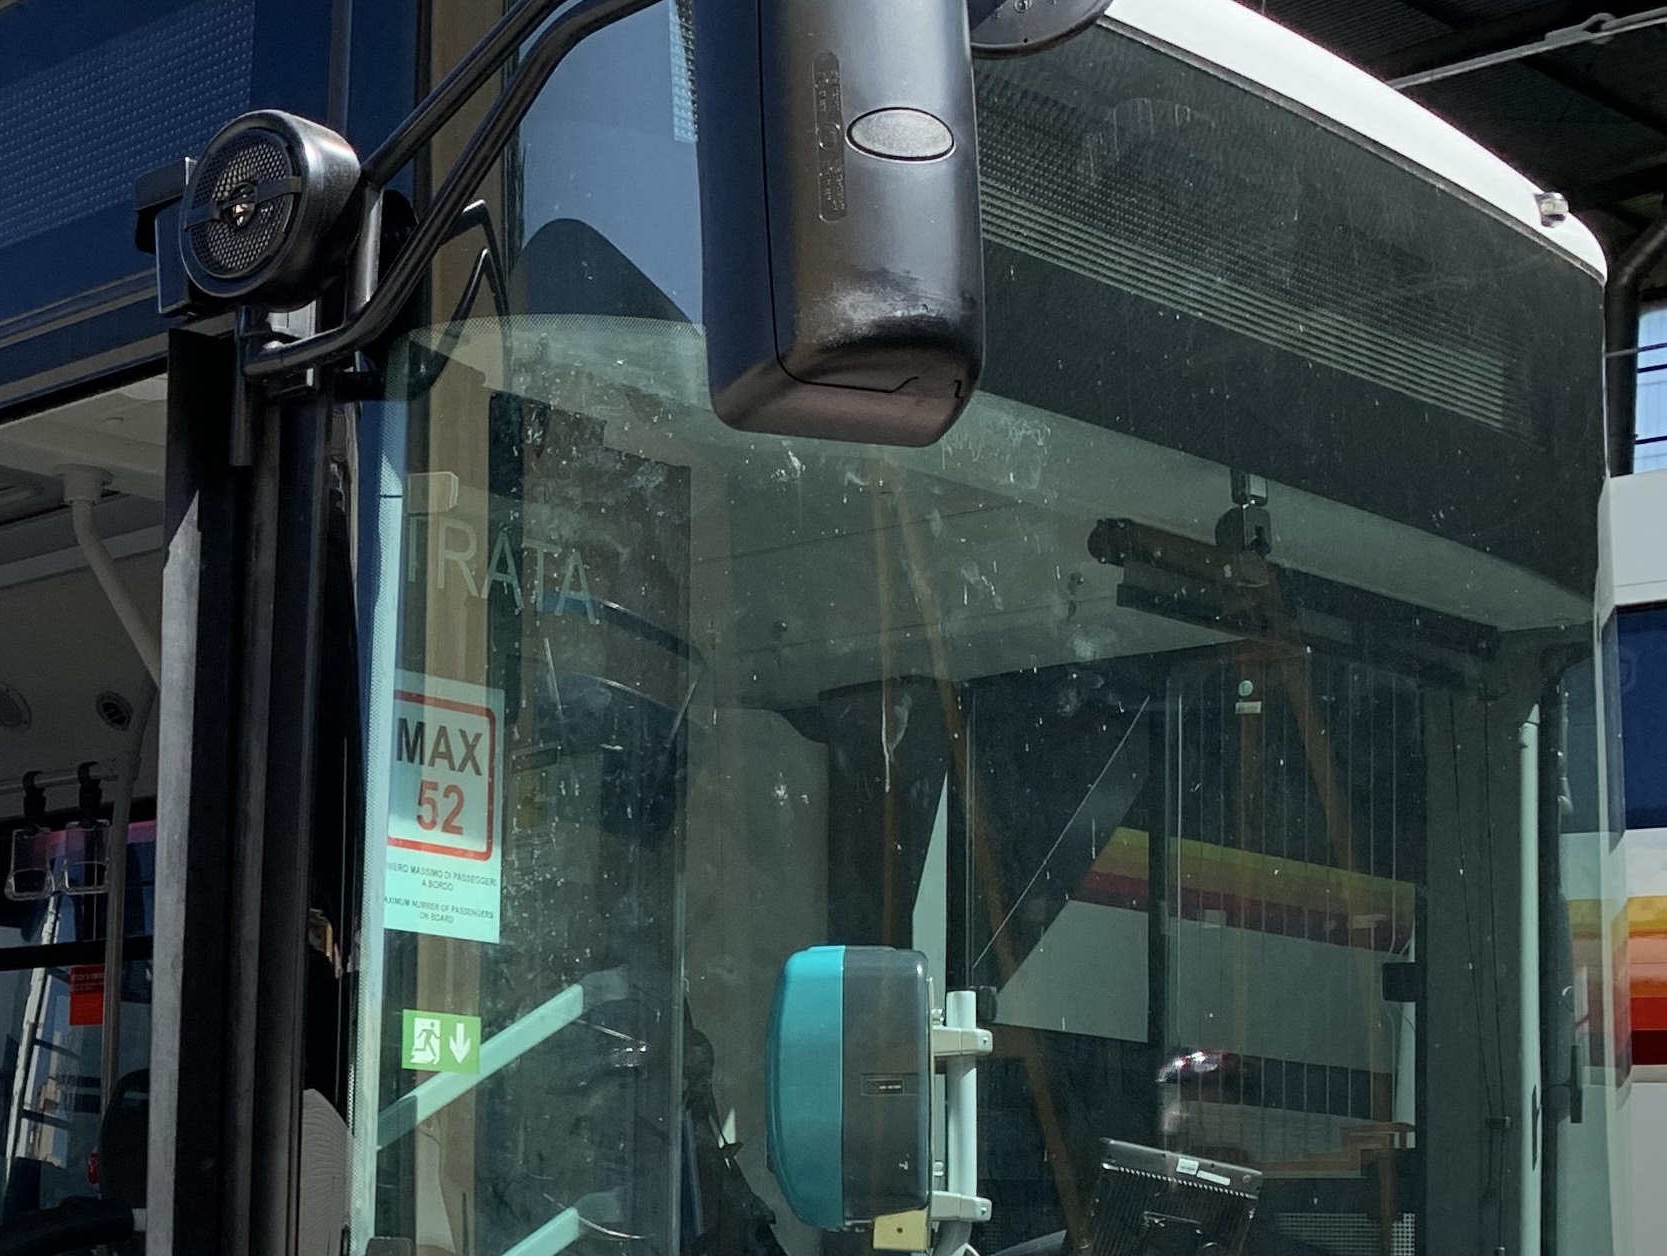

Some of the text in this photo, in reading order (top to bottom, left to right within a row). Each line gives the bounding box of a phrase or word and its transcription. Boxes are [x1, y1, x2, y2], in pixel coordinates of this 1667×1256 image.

[397, 718, 482, 776] MAX
[416, 779, 465, 836] 52
[384, 896, 410, 906] AXIMUM
